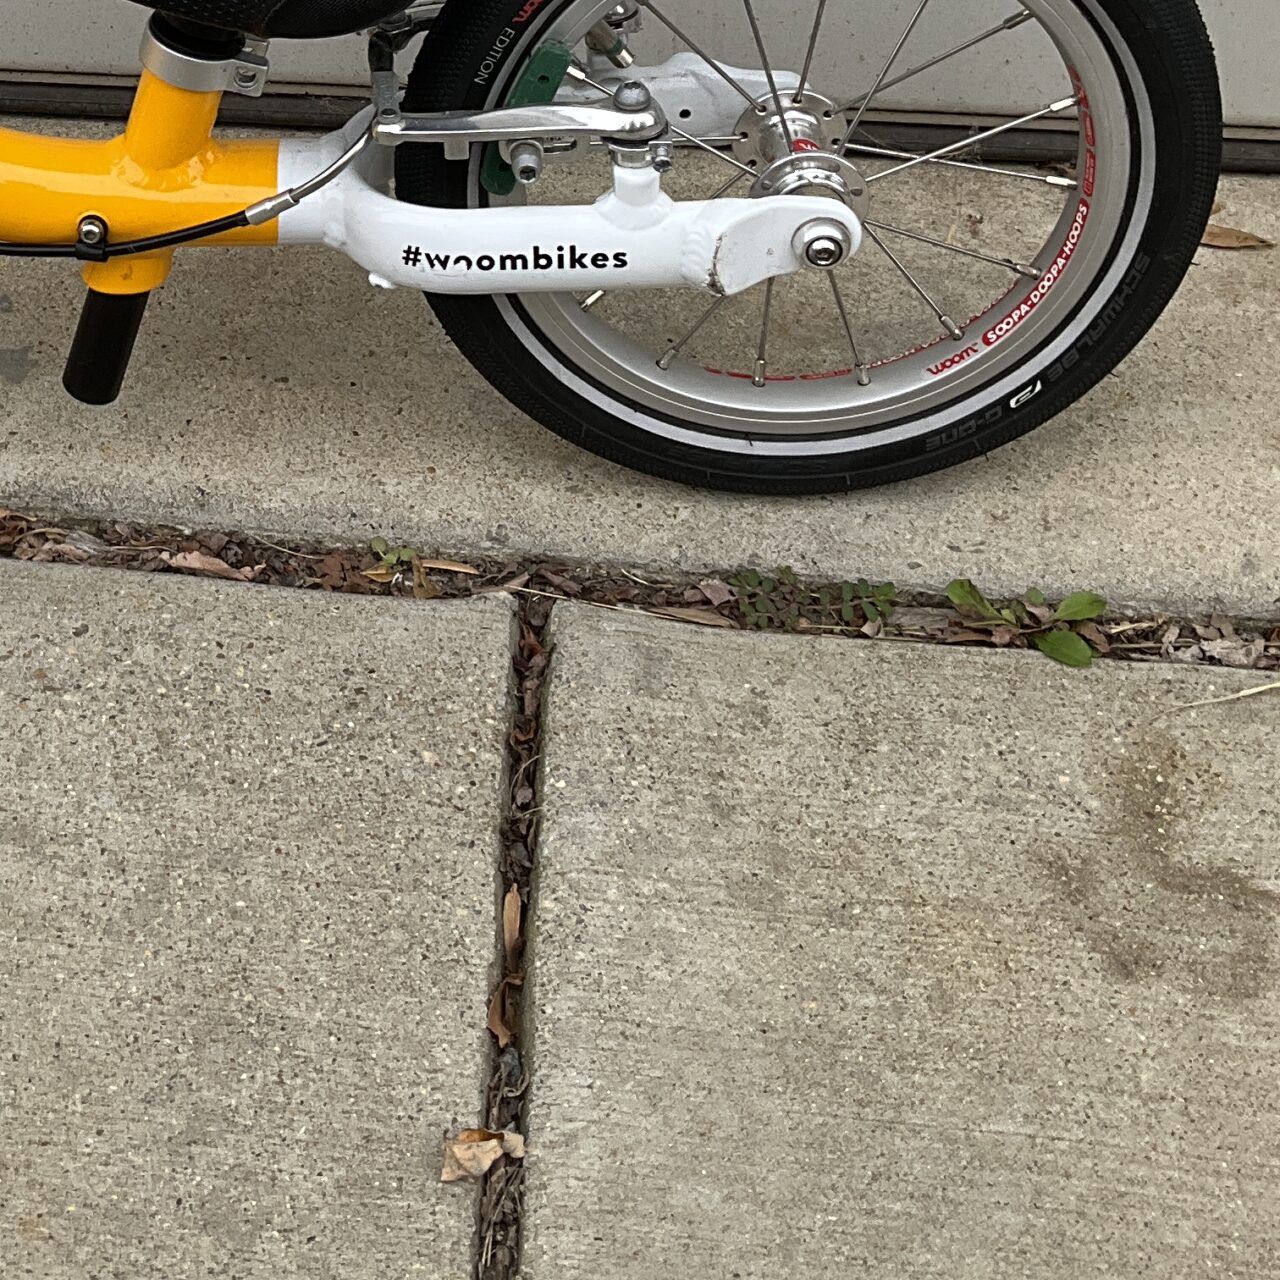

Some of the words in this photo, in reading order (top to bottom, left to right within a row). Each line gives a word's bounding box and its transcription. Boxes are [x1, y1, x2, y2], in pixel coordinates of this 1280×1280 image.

[474, 27, 516, 85] EDITION
[402, 245, 628, 271] #woombikes
[986, 202, 1088, 343] SOOPA-DOOPA-HOOPS
[1046, 253, 1151, 382] SCHWALBE
